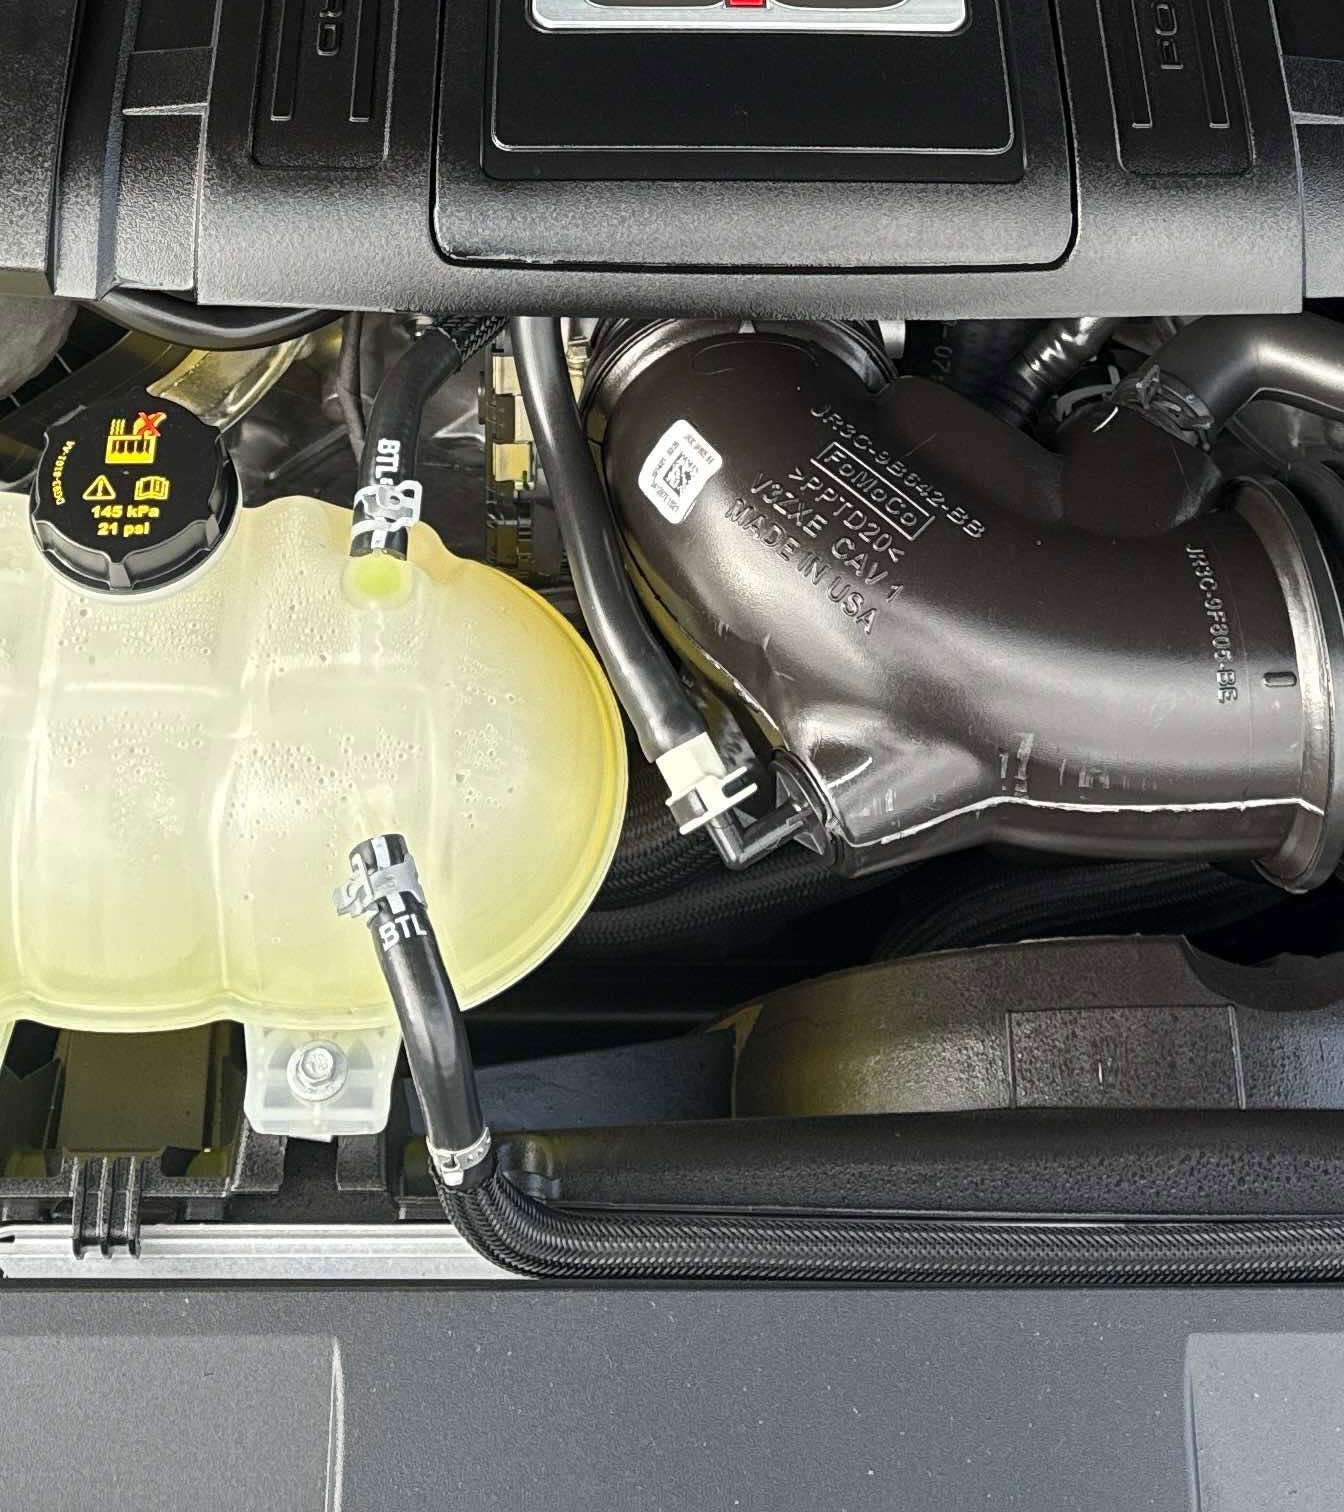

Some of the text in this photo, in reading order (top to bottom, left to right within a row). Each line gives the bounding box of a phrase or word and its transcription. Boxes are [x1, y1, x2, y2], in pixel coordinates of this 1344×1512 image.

[375, 438, 401, 479] BTL
[810, 402, 987, 540] JR3C-9B642-BB
[822, 448, 920, 530] FoMoCo
[91, 504, 160, 519] 145 kPa
[96, 522, 151, 538] 21 psi
[749, 473, 830, 540] V3ZXE
[831, 535, 887, 586] CAV
[885, 583, 905, 606] 1
[724, 496, 881, 635] MADE IN USA
[378, 913, 428, 952] BTL
